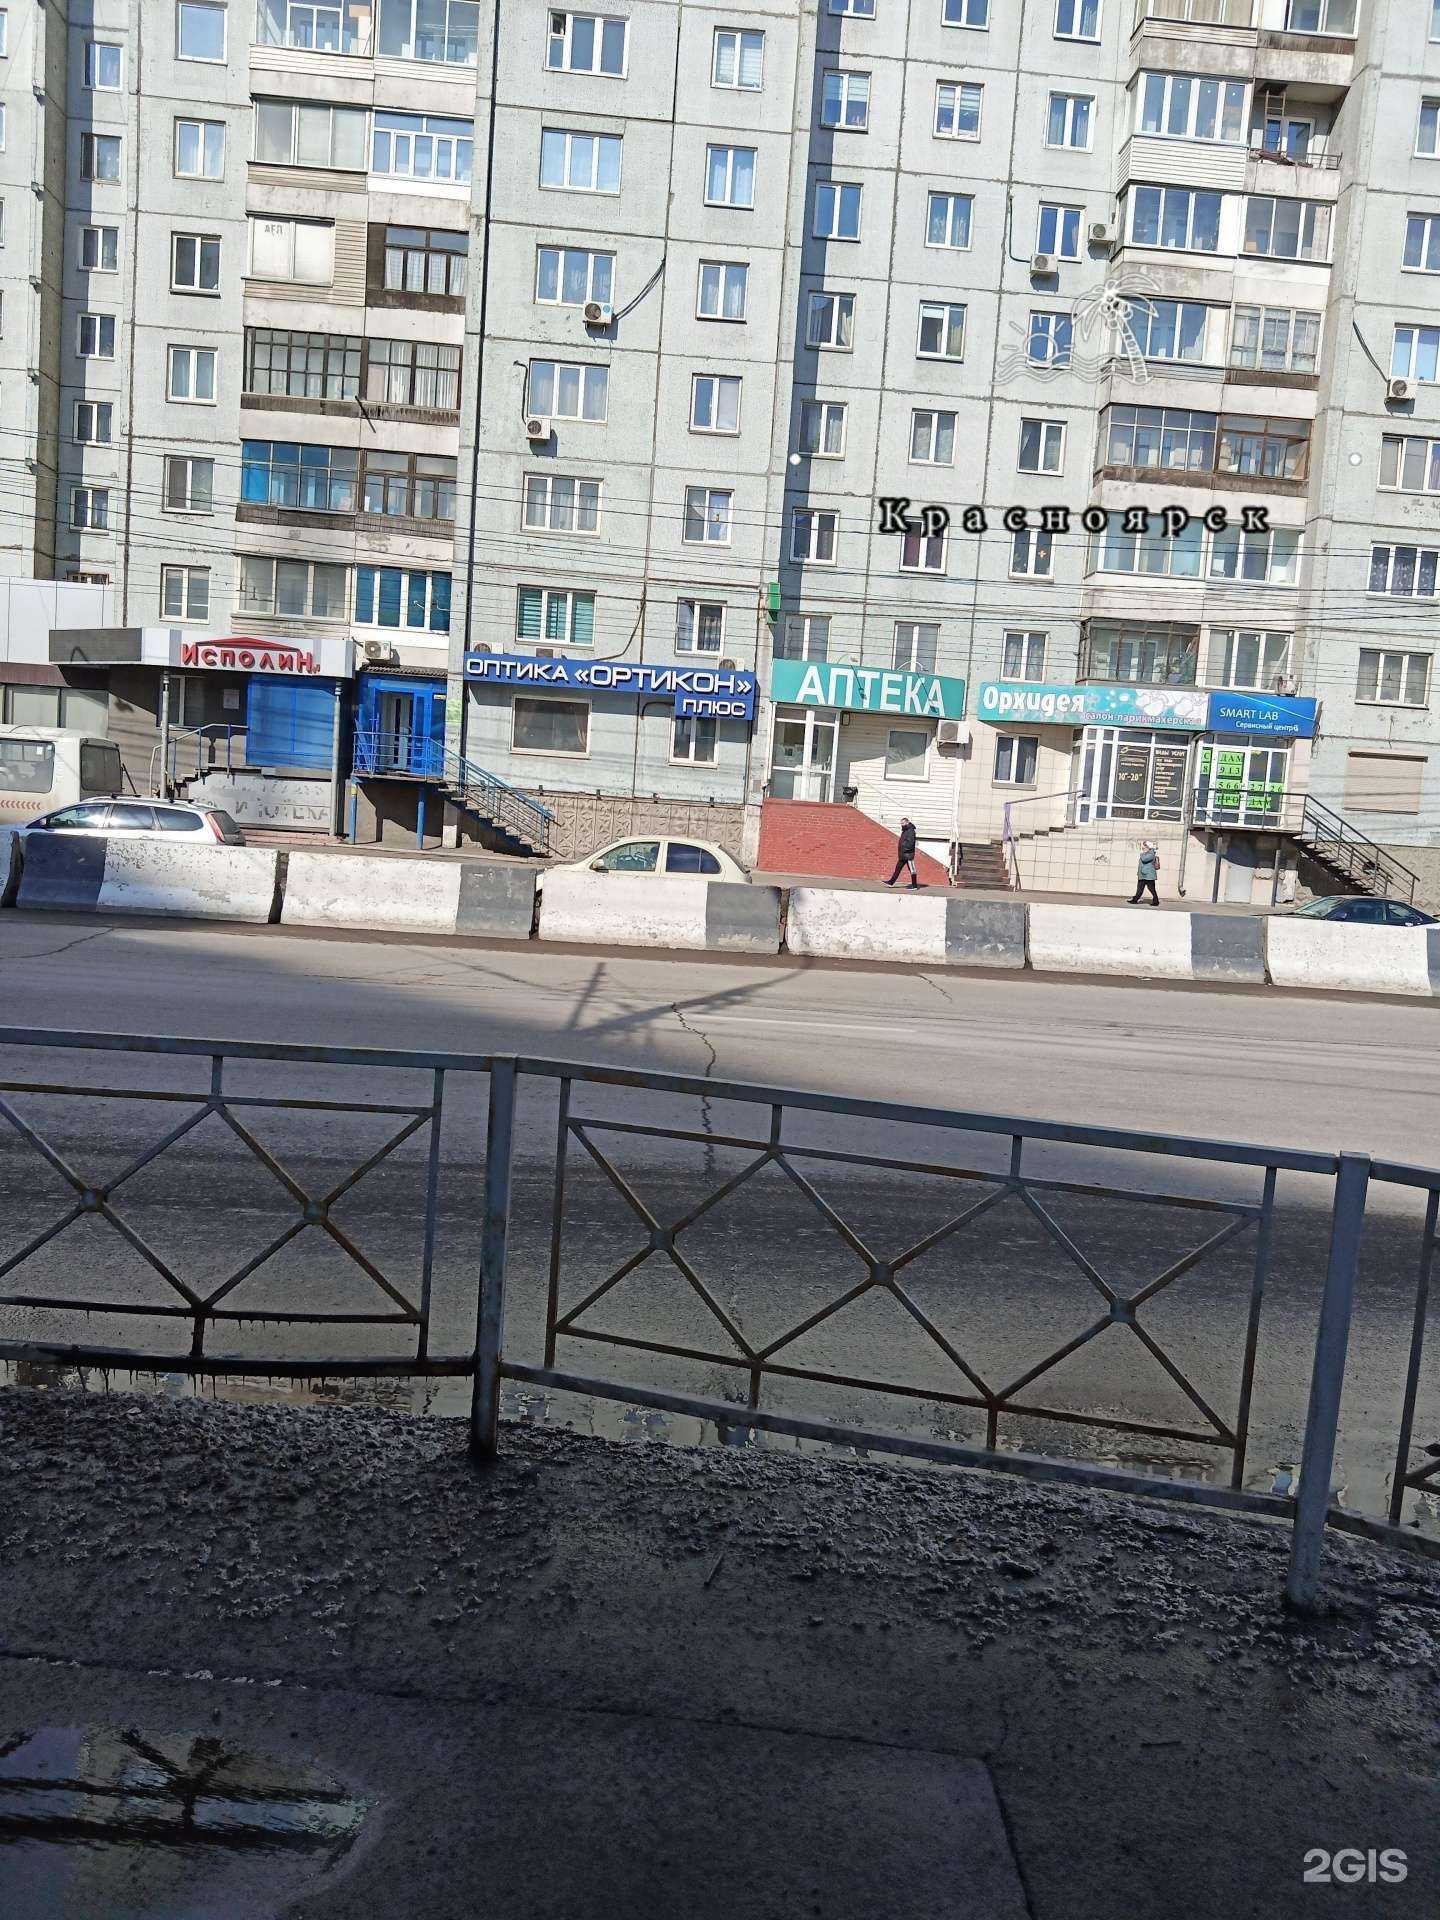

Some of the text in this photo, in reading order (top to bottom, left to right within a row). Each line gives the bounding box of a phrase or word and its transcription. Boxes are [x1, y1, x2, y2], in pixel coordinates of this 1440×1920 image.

[181, 642, 313, 675] ИСПОЛИН
[466, 657, 752, 695] ОПТИКА «ОРТИКОН»
[795, 664, 946, 719] АПТЕКА
[681, 698, 747, 718] ПЛЮС
[983, 685, 1086, 716] Орхидея
[1219, 706, 1280, 721] SMART LAB
[1235, 719, 1274, 731] Сервисный
